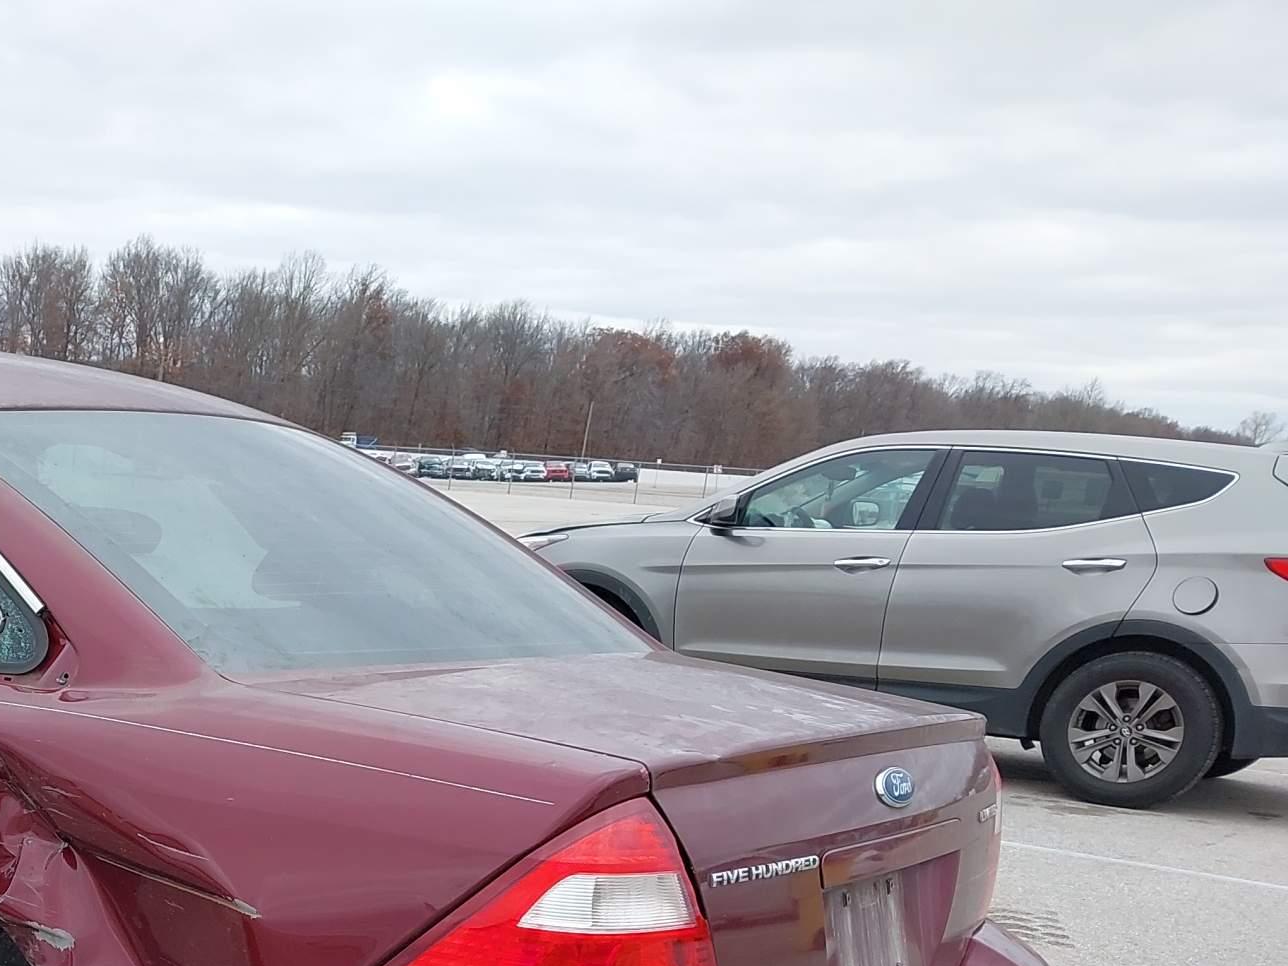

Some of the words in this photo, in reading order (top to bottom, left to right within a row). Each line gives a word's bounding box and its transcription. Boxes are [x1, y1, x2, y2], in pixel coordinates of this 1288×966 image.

[891, 772, 912, 796] Ford
[711, 867, 750, 888] FIVE
[751, 855, 820, 880] HUNDRED
